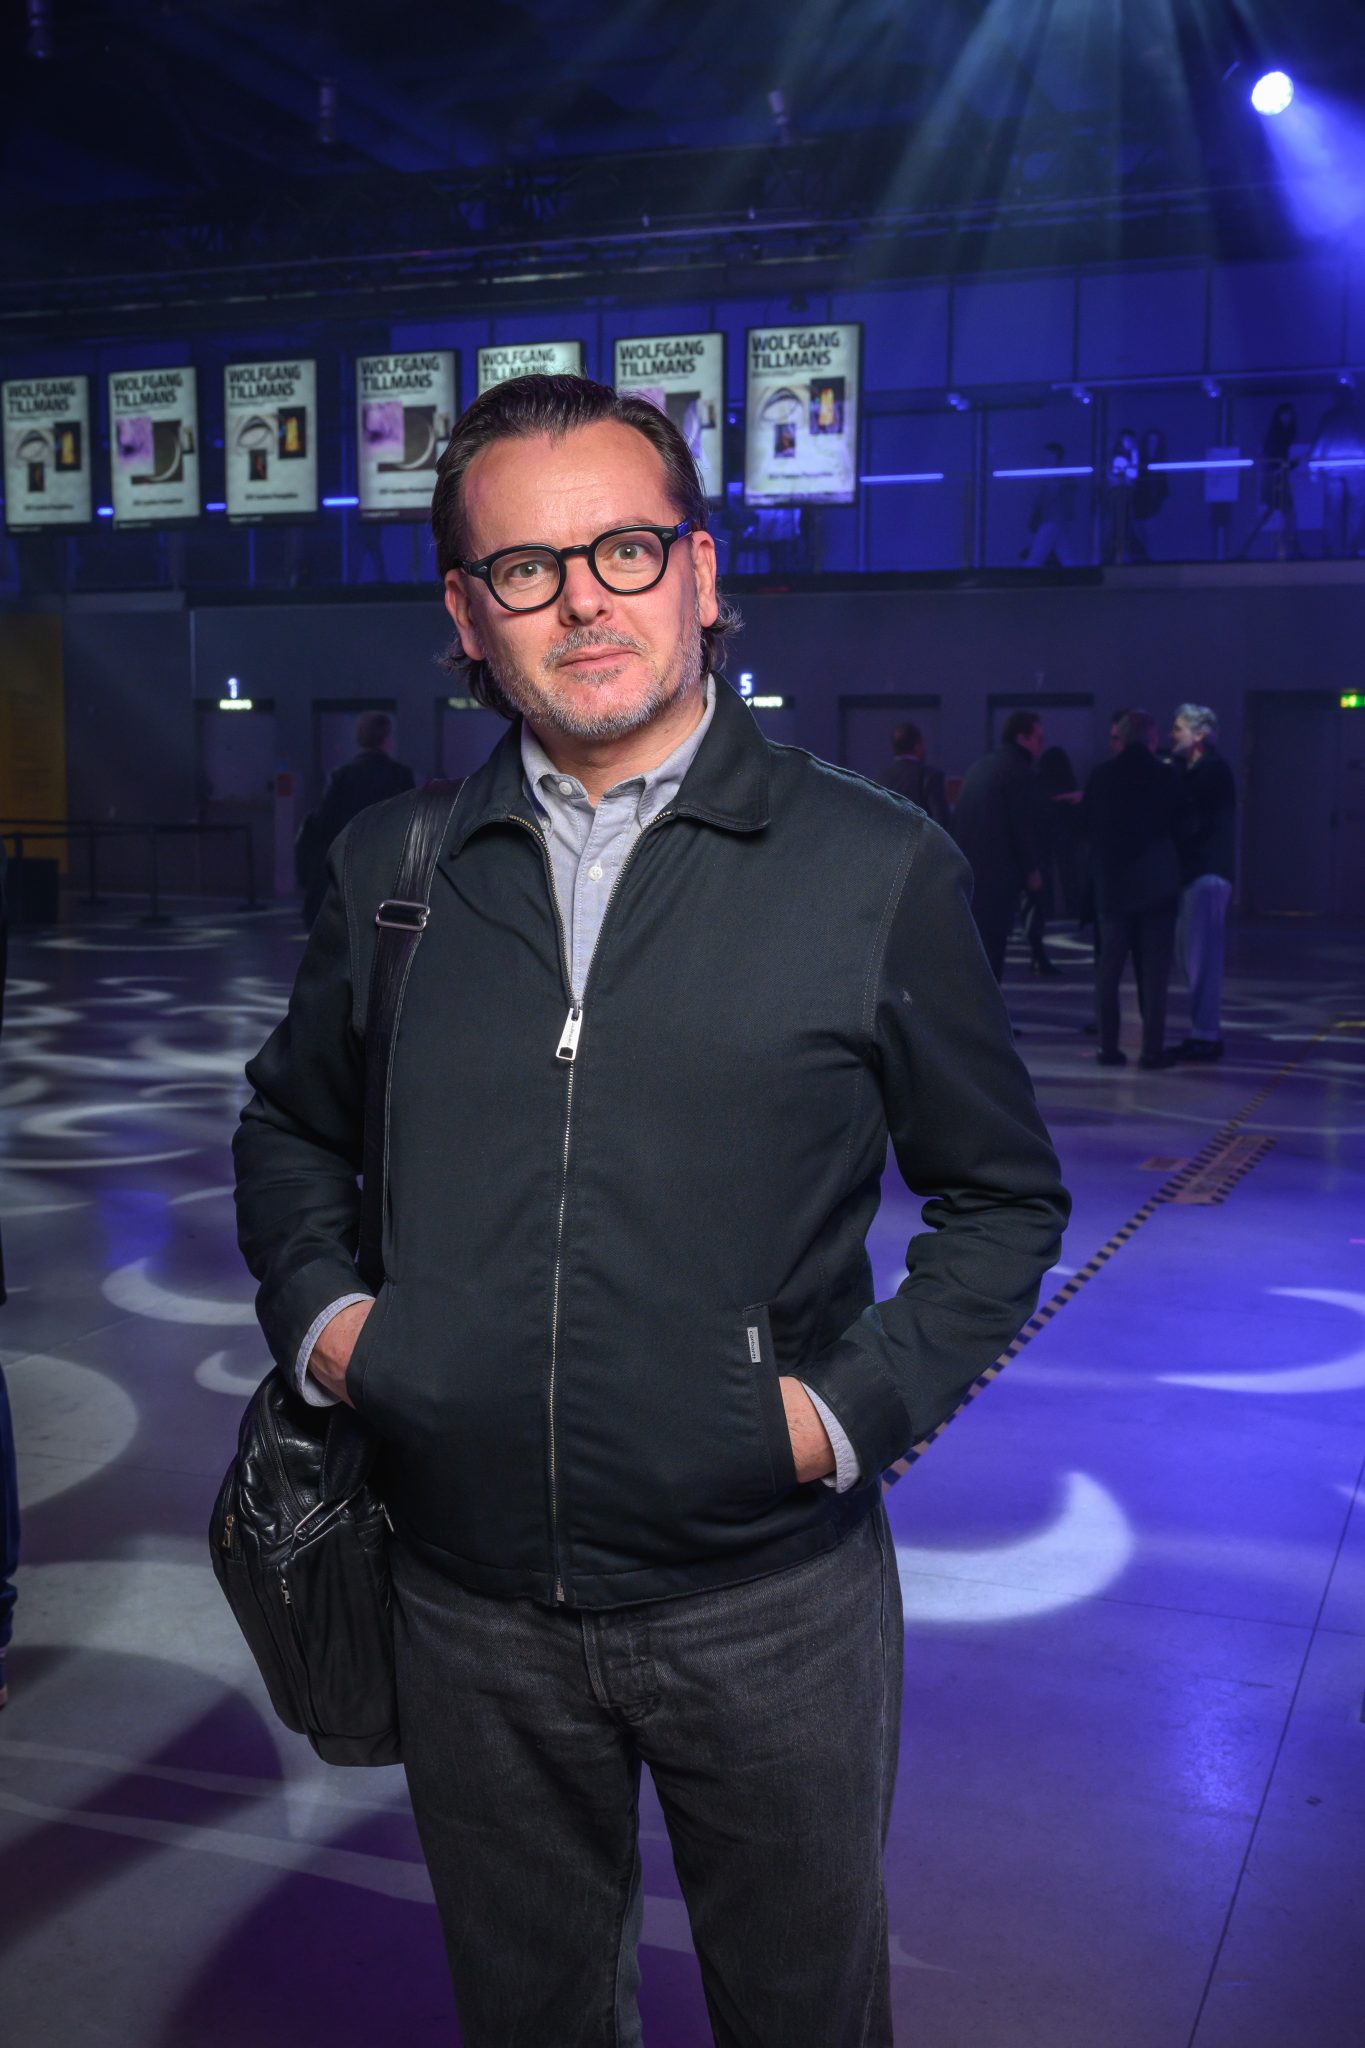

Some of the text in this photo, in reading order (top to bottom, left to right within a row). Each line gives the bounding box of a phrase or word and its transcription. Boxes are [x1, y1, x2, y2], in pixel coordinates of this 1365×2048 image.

[620, 340, 704, 359] WOLFGANG
[752, 332, 839, 352] WOLFGANG
[361, 356, 440, 374] WOLFGANG
[481, 348, 555, 365] WOLFGANG
[752, 350, 831, 369] TILLMANS
[228, 365, 301, 382] WOLFGANG
[620, 359, 695, 376] TILLMANS
[113, 373, 183, 391] WOLFGANG
[229, 382, 294, 399] TILLMANS
[362, 373, 432, 390] TILLMANS
[115, 389, 177, 407] TILLMANS
[228, 678, 238, 699] 1
[740, 672, 752, 696] 5
